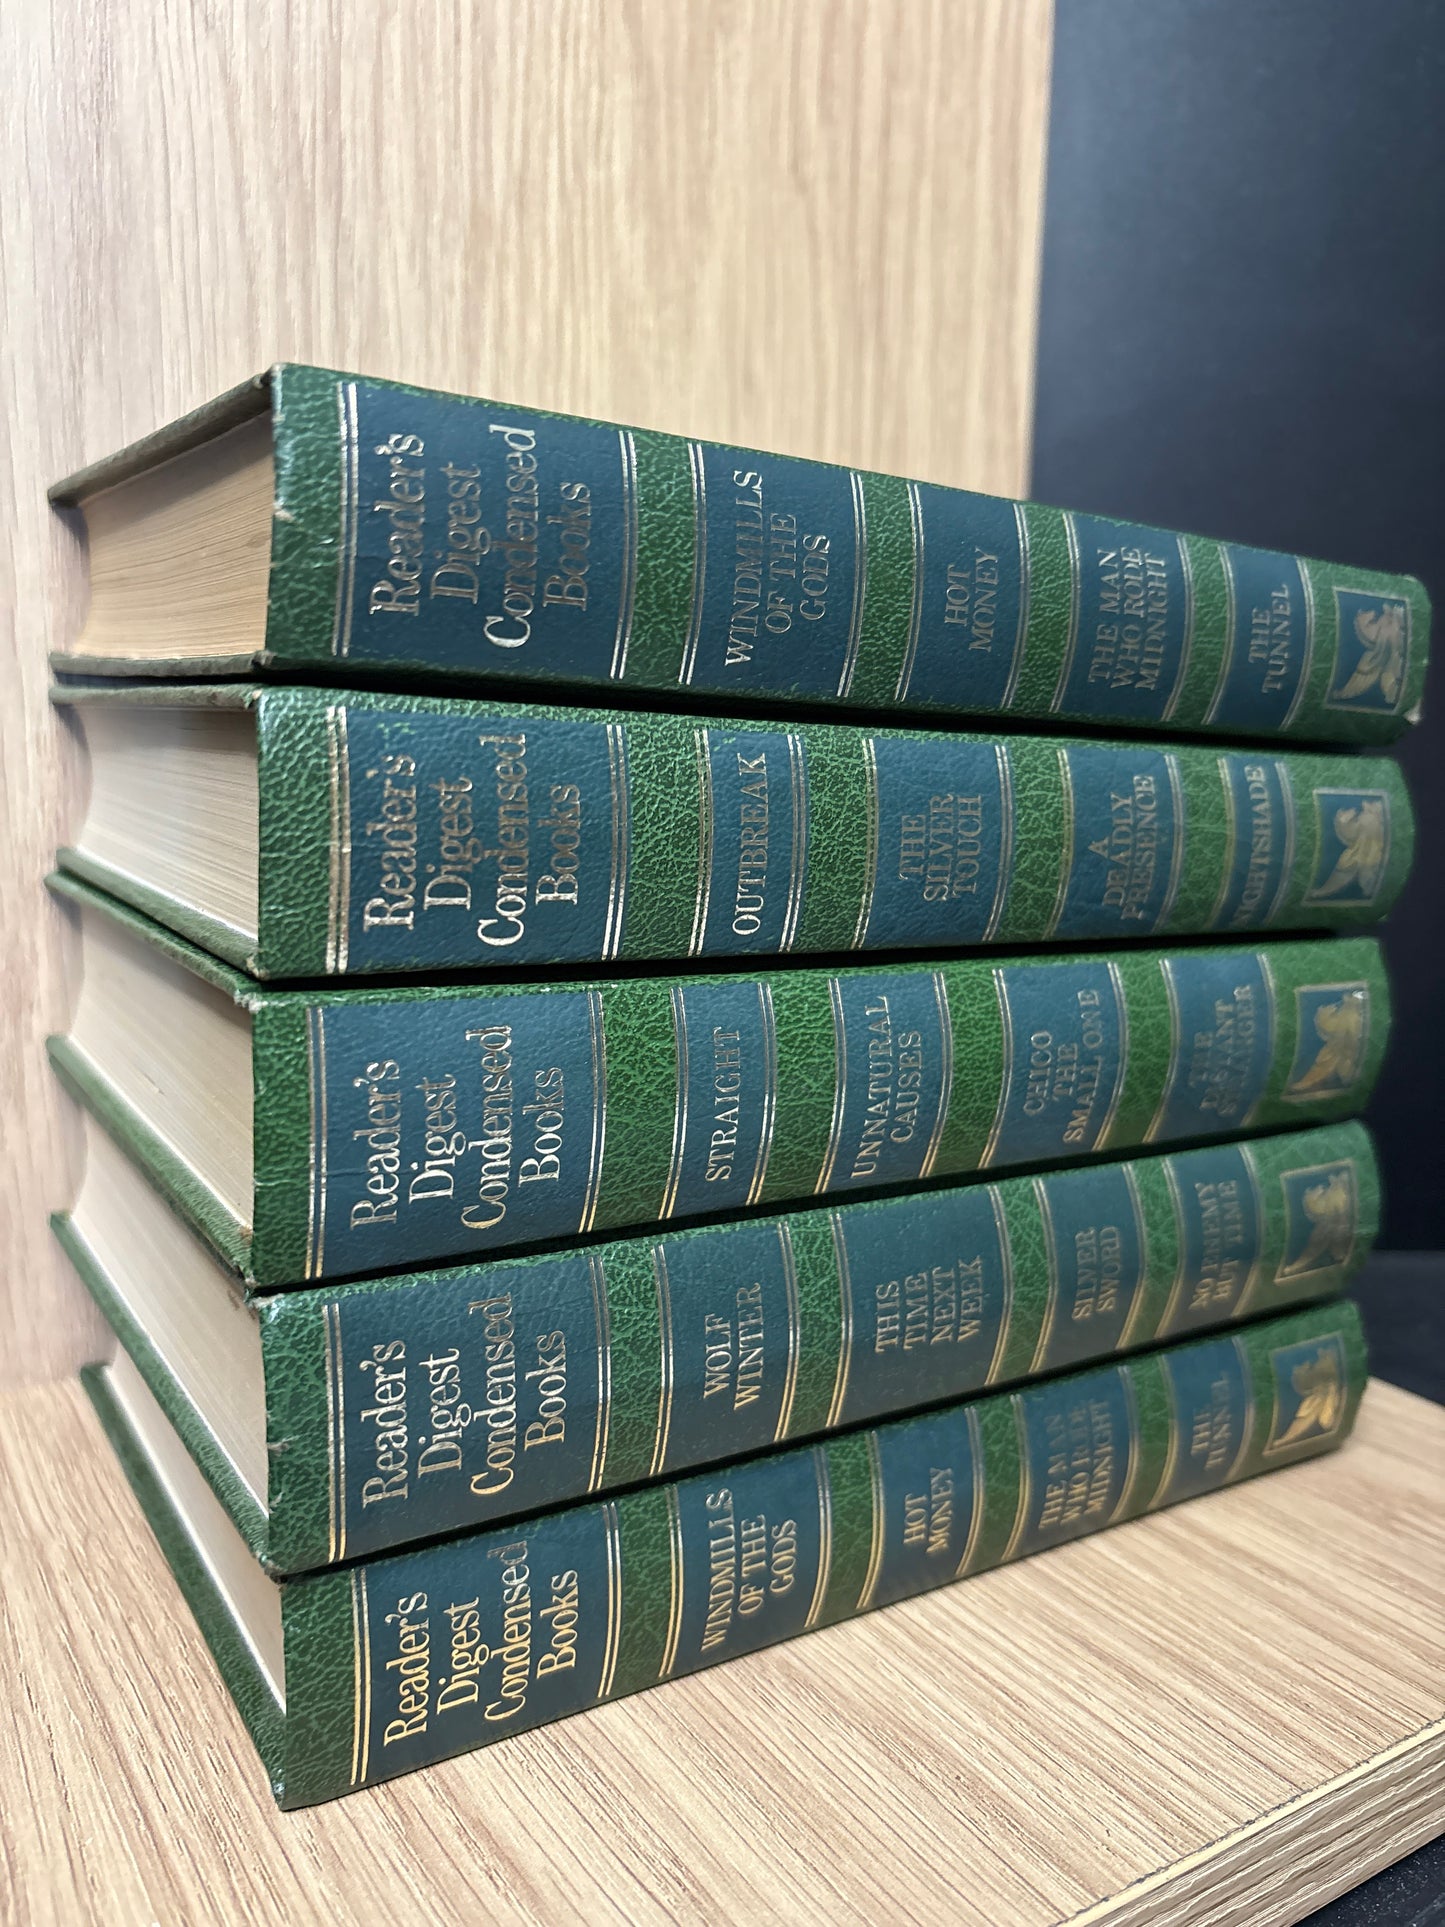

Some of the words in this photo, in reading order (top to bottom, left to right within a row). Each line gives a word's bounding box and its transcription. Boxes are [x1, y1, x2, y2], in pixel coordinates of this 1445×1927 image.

[369, 433, 425, 616] Reader's
[430, 461, 490, 604] Digest
[483, 424, 539, 648] Condensed
[542, 482, 592, 611] Books
[725, 470, 763, 666] WINDMILLS
[769, 512, 797, 581] THE
[800, 534, 830, 620] GODS
[765, 590, 794, 634] OF
[944, 563, 971, 627] HOT
[968, 545, 999, 652] MONEY
[1097, 549, 1121, 615] MAN
[1135, 553, 1168, 691] MIDNIGHT
[1248, 607, 1270, 663] THE
[1088, 623, 1119, 683] THE
[1110, 624, 1142, 689] WHO
[1261, 584, 1291, 693] TUNNEL
[363, 754, 417, 932] Reader's
[423, 776, 483, 910] Digest
[477, 734, 529, 946] Condensed
[536, 784, 581, 905] Books
[732, 753, 769, 935] OUTBREAK
[899, 814, 926, 880] THE
[923, 793, 954, 902] SILVER
[951, 793, 982, 899] TOUCH
[1088, 837, 1110, 860] A
[1102, 791, 1133, 906] DEADLY
[1120, 775, 1157, 920] PRESENCE
[1231, 764, 1272, 928] NIGHTSHADE
[1023, 1030, 1053, 1117] CHICO
[1053, 1043, 1078, 1102] THE
[1077, 989, 1103, 1049] ONE
[408, 1073, 466, 1204] Digest
[460, 1025, 513, 1229] Condensed
[518, 1067, 565, 1188] Books
[705, 1026, 741, 1182] STRAIGHT
[851, 996, 893, 1178] UNNATURAL
[890, 1030, 922, 1143] CAUSES
[1063, 1055, 1103, 1143] SMALL
[350, 1059, 401, 1229] Reader's
[874, 1280, 900, 1353] THIS
[902, 1271, 929, 1350] TIME
[929, 1265, 956, 1346] NEXT
[956, 1254, 984, 1343] WEEK
[1071, 1226, 1098, 1321] SILVER
[1096, 1225, 1122, 1313] SWORD
[468, 1292, 517, 1495] Condensed
[524, 1330, 567, 1451] Books
[703, 1313, 733, 1400] WOLF
[733, 1281, 764, 1411] WINTER
[359, 1339, 409, 1509] Reader's
[417, 1348, 472, 1478] Digest
[741, 1514, 767, 1578] THE
[769, 1519, 797, 1593] GODS
[903, 1493, 928, 1544] HOT
[926, 1467, 954, 1554] MONEY
[536, 1569, 578, 1680] Books
[700, 1488, 736, 1651] WINDMILLS
[738, 1586, 764, 1616] OF
[384, 1591, 430, 1747] Reader's
[436, 1597, 490, 1715] Digest
[484, 1541, 531, 1721] Condensed
